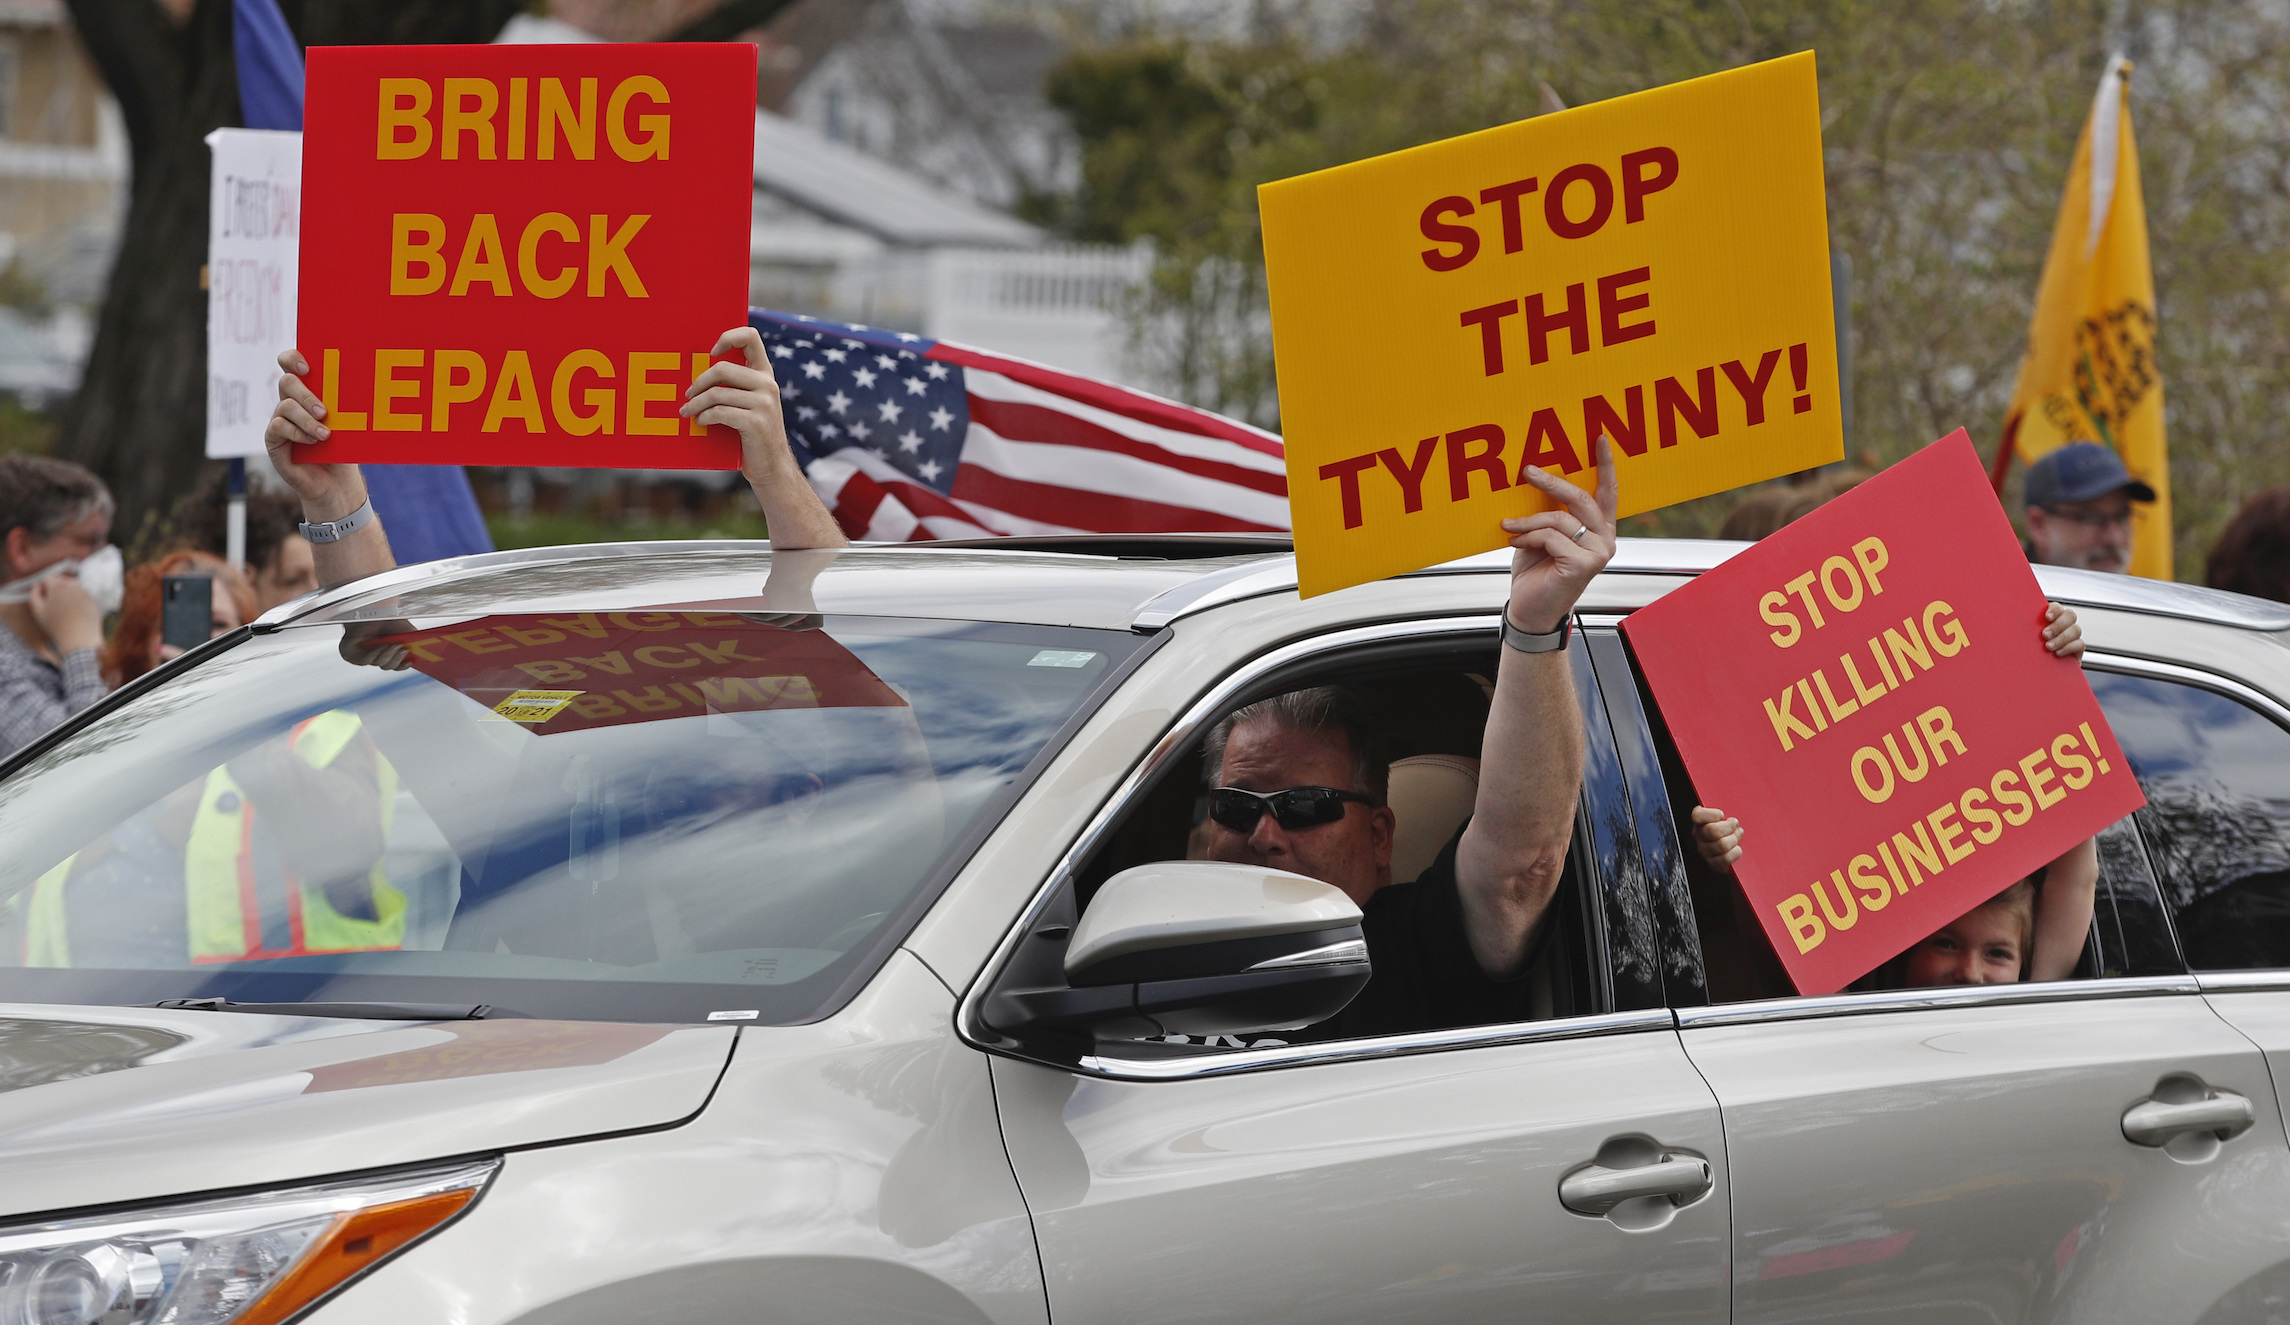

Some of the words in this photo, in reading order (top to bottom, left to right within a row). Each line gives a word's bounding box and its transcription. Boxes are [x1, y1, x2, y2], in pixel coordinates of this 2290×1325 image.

[376, 75, 671, 162] BRING
[390, 212, 652, 299] BACK
[1419, 146, 1680, 272] STOP
[1460, 266, 1656, 377] THE
[1318, 342, 1812, 530] TYRANNY!
[1758, 536, 1890, 649] STOP
[530, 707, 552, 716] 21
[1762, 600, 1971, 752] KILLING
[1850, 705, 1968, 804] OUR
[1776, 721, 2111, 955] BUSINESSES!
